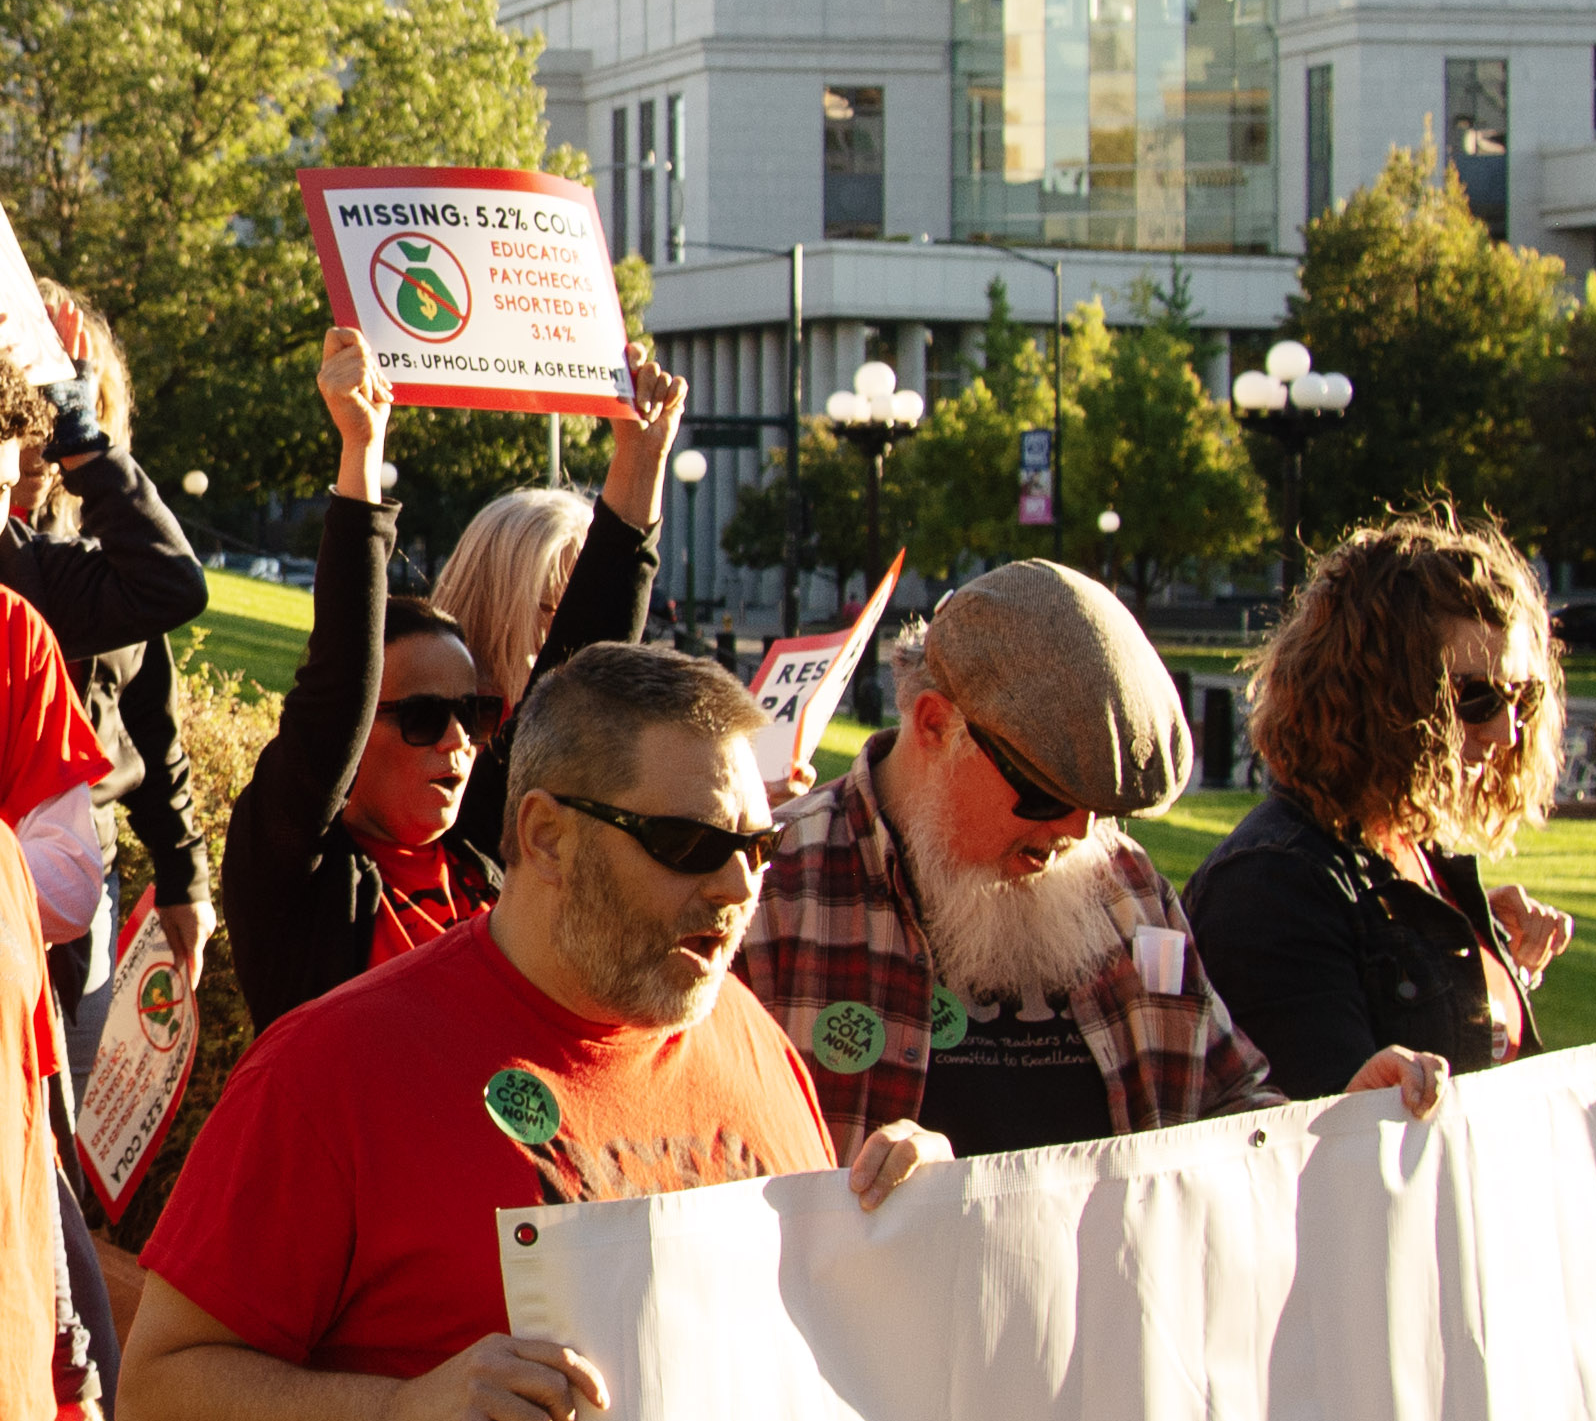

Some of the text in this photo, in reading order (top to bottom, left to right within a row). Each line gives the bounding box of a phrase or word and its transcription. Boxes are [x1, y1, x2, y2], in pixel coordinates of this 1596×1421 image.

[338, 203, 588, 239] MISSING: 5.2% COLA
[490, 240, 582, 265] EDUCATOR
[489, 267, 595, 293] PAYCHECKS
[493, 294, 598, 319] SHORTED BY
[531, 323, 577, 343] 3.14%
[377, 352, 627, 384] DPS: UPHOLD OUR AGREEMENT
[826, 1015, 872, 1053] COLA
[840, 1006, 876, 1036] 5.2%
[821, 1032, 864, 1063] NOW!
[505, 1073, 544, 1100] 5.2%
[495, 1086, 550, 1119] COLA
[501, 1104, 545, 1131] NOW!
[110, 1134, 143, 1184] COLA
